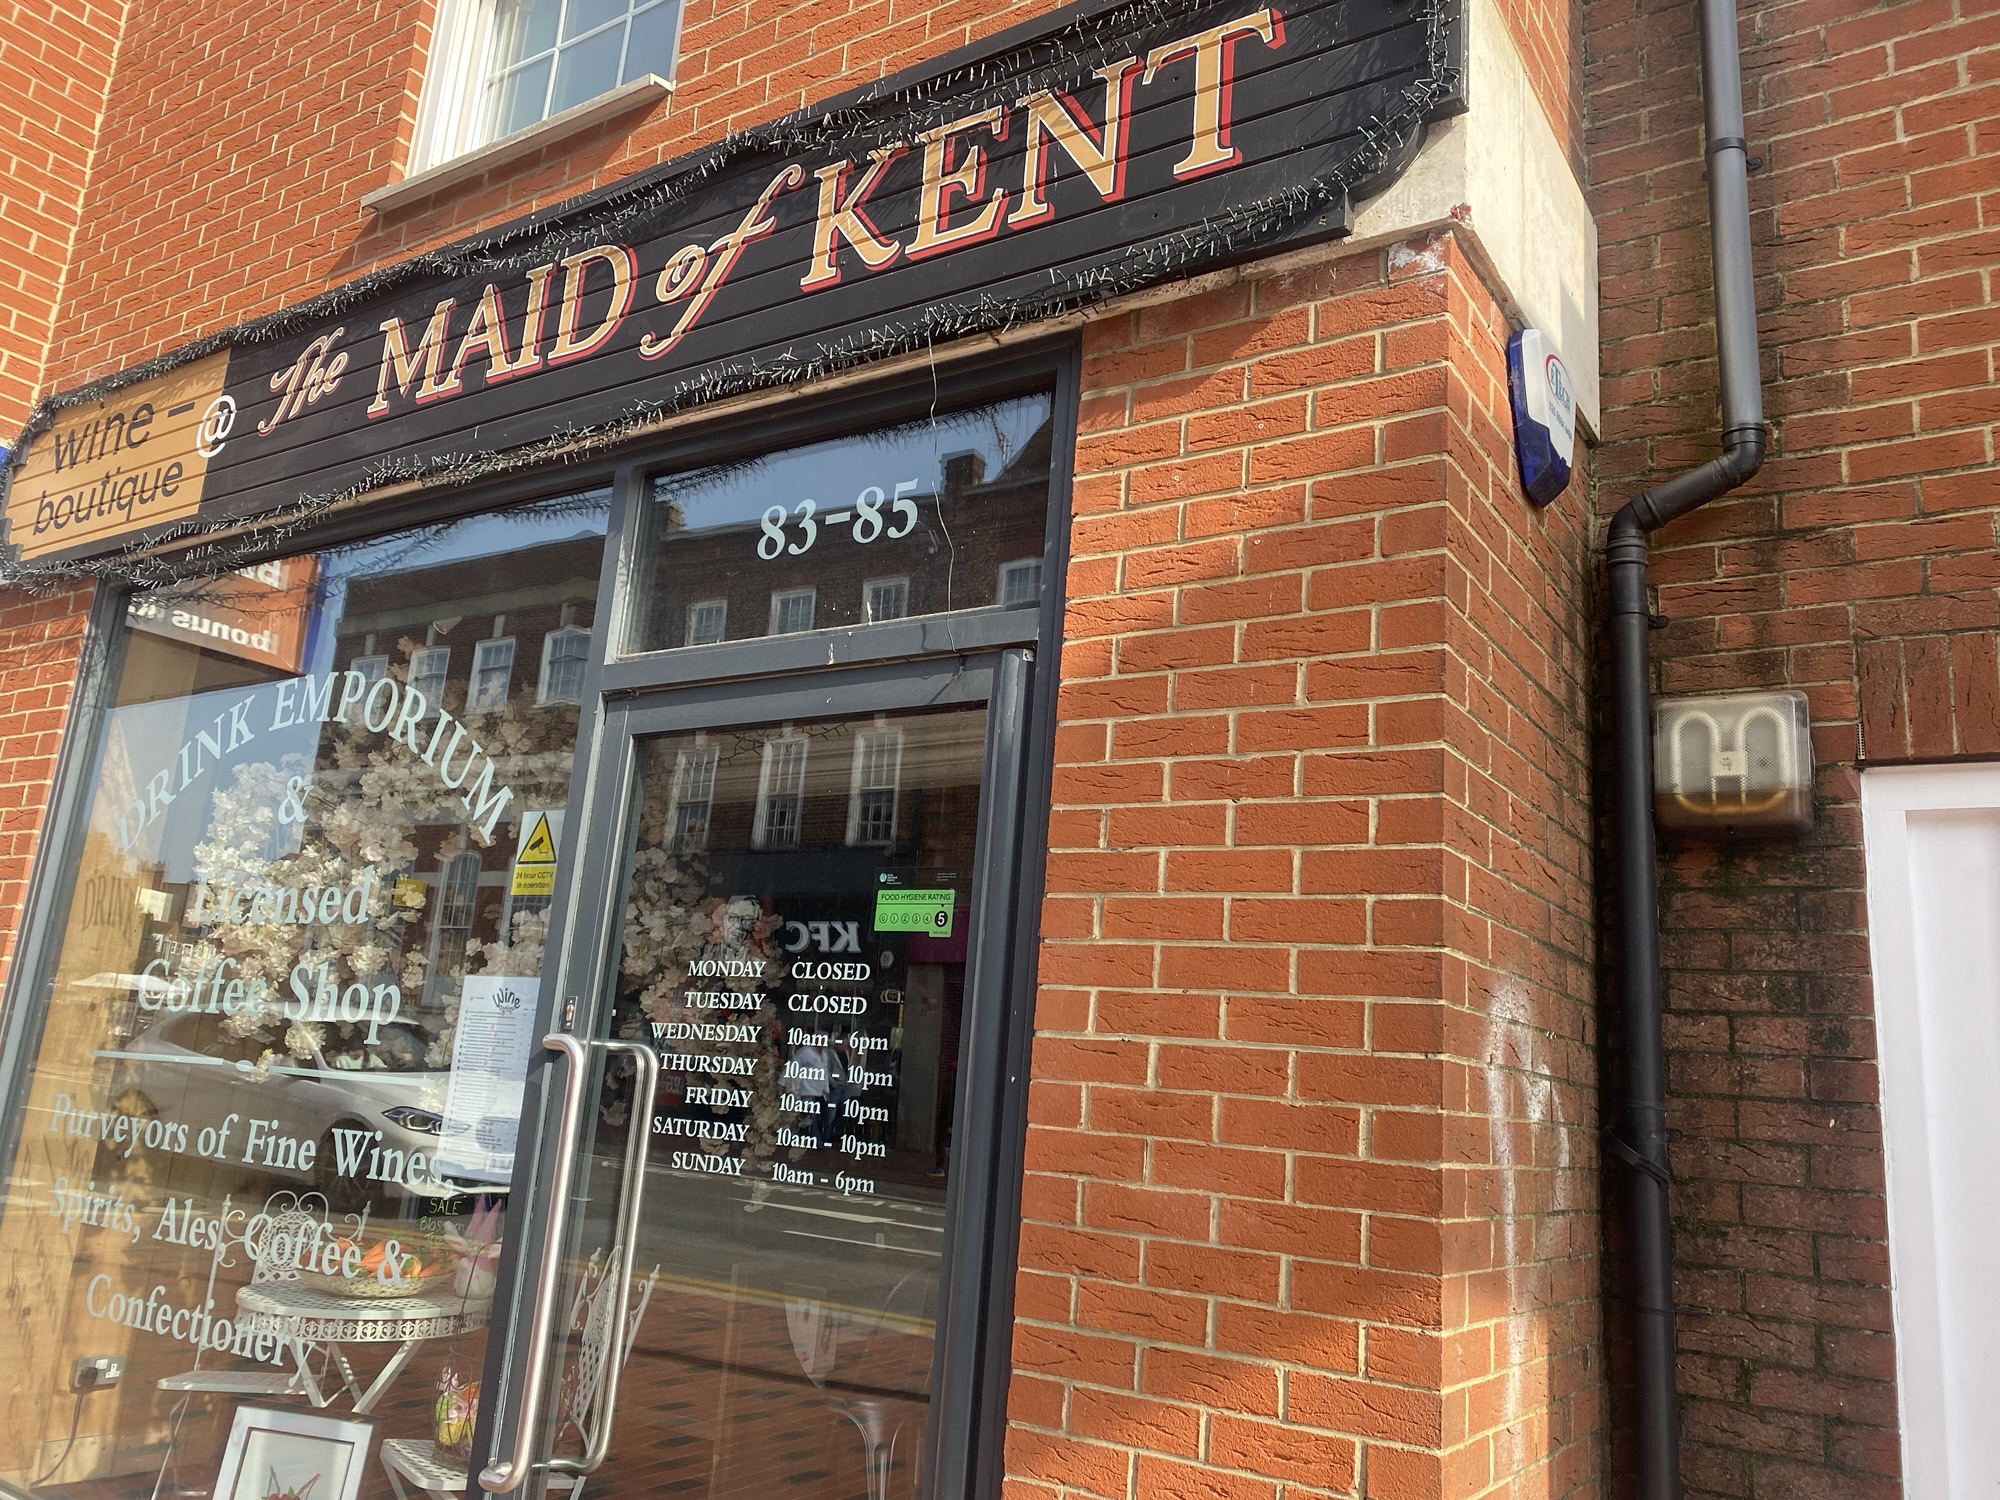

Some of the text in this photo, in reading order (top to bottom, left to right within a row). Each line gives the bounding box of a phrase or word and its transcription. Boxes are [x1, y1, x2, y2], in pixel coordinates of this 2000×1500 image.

[196, 8, 1287, 458] @ The MAID of KENT
[32, 461, 184, 536] boutique
[756, 477, 920, 561] 83-85
[119, 670, 515, 854] DRINK EMPORIUM
[277, 775, 315, 826] &
[190, 864, 375, 925] Licensed
[523, 871, 537, 879] hour
[537, 871, 555, 879] CCTV
[523, 881, 550, 889] operation
[881, 893, 951, 901] FOOD HYGIENE RATING
[687, 960, 871, 982] MONDAY CLOSED
[138, 956, 401, 1045] Coffee Shop
[684, 991, 868, 1015] TUESDAY CLOSED
[650, 1021, 762, 1043] WEDNESDAY
[786, 1027, 829, 1048] 10am
[849, 1031, 889, 1054] 6pm
[659, 1052, 758, 1077] THURSDAY
[783, 1060, 825, 1082] 10am
[847, 1065, 894, 1091] 10pm
[684, 1086, 754, 1109] FRIDAY
[778, 1093, 821, 1115] 10am
[843, 1098, 889, 1126] 10pm
[48, 1093, 189, 1159] Purveyors
[196, 1113, 240, 1159] of
[241, 1118, 317, 1172] Fine
[652, 1116, 750, 1143] SATURDAY
[775, 1127, 818, 1150] 10am
[839, 1133, 887, 1161] 10pm
[671, 1150, 747, 1177] SUNDAY
[771, 1162, 815, 1186] 10am
[834, 1169, 876, 1196] 6pm
[429, 1197, 462, 1216] SALE
[50, 1176, 412, 1289] Spirits, Ales, Coffee &
[86, 1272, 316, 1389] Confectionery
